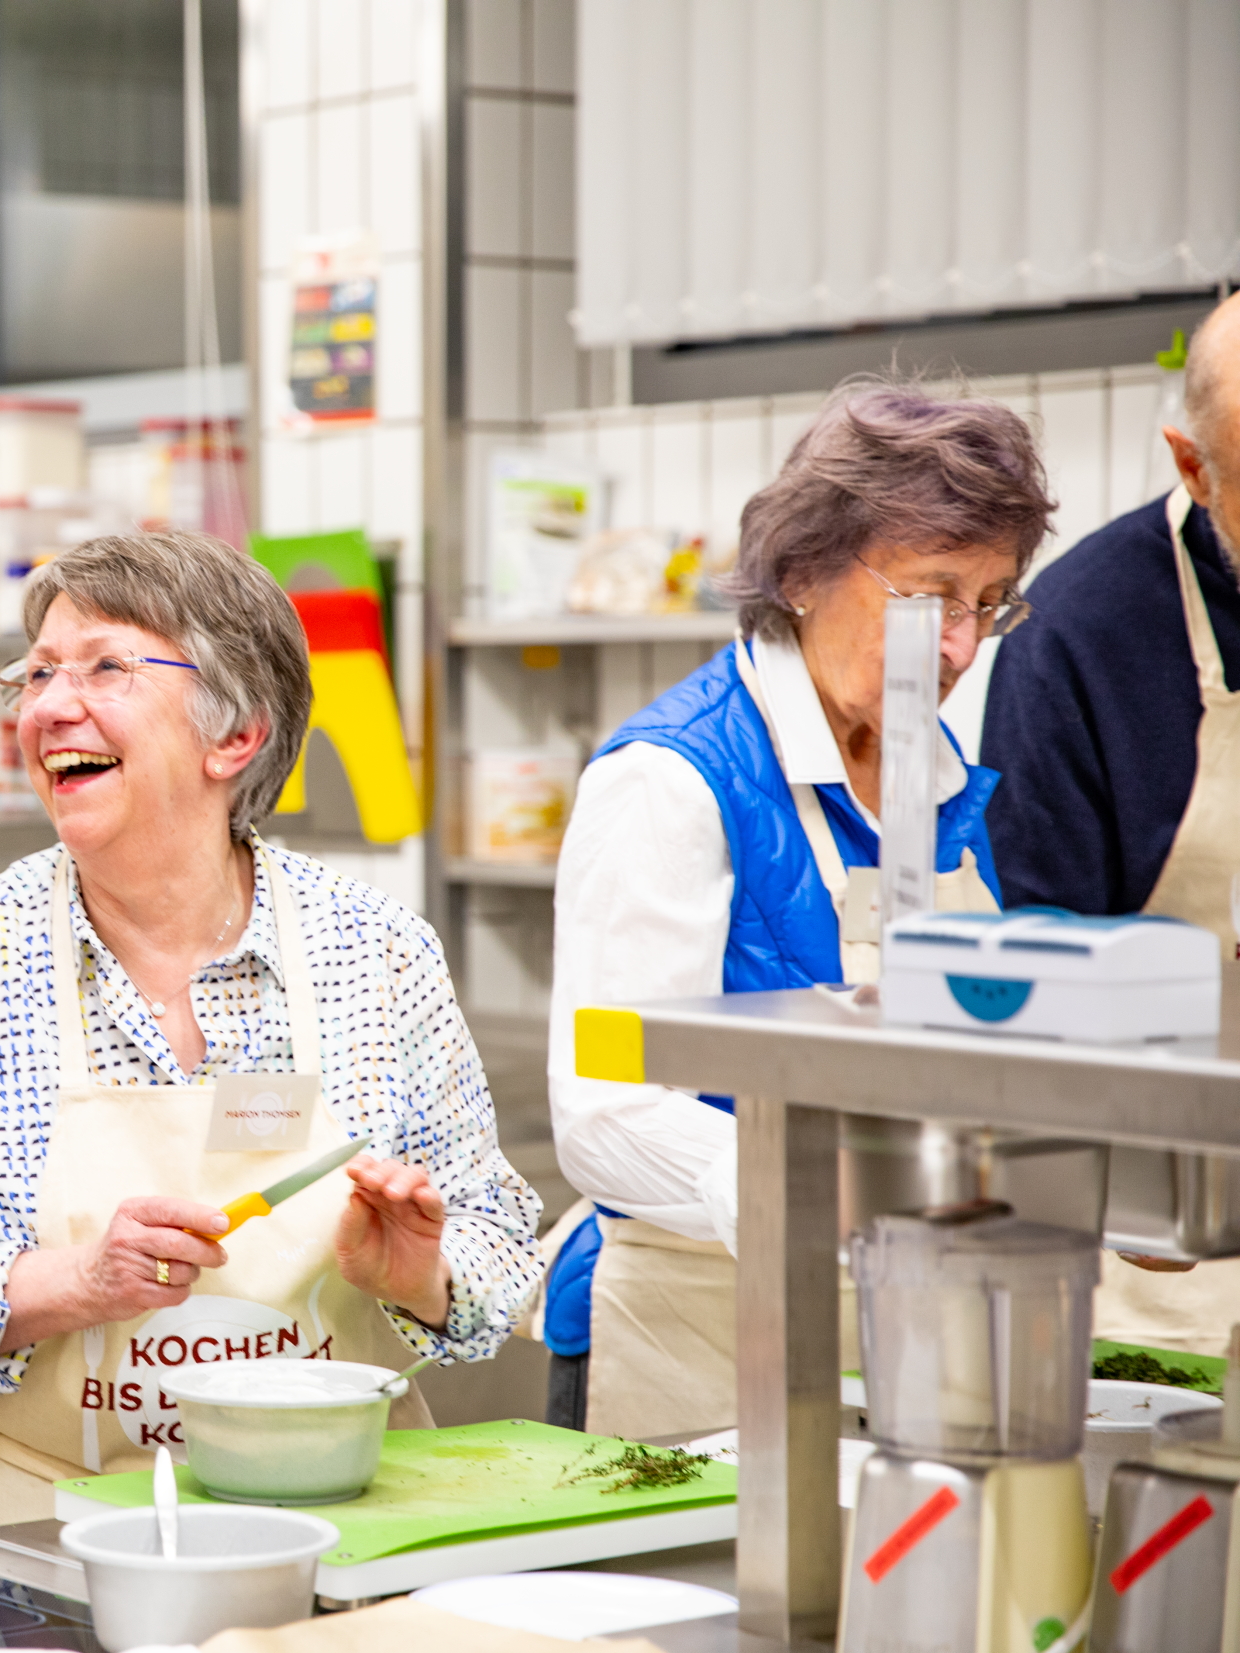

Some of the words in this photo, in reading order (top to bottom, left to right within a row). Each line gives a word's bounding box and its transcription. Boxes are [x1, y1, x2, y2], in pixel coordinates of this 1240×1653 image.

[225, 1110, 259, 1119] MARION
[130, 1320, 300, 1367] KOCHEN
[81, 1377, 142, 1412] BIS
